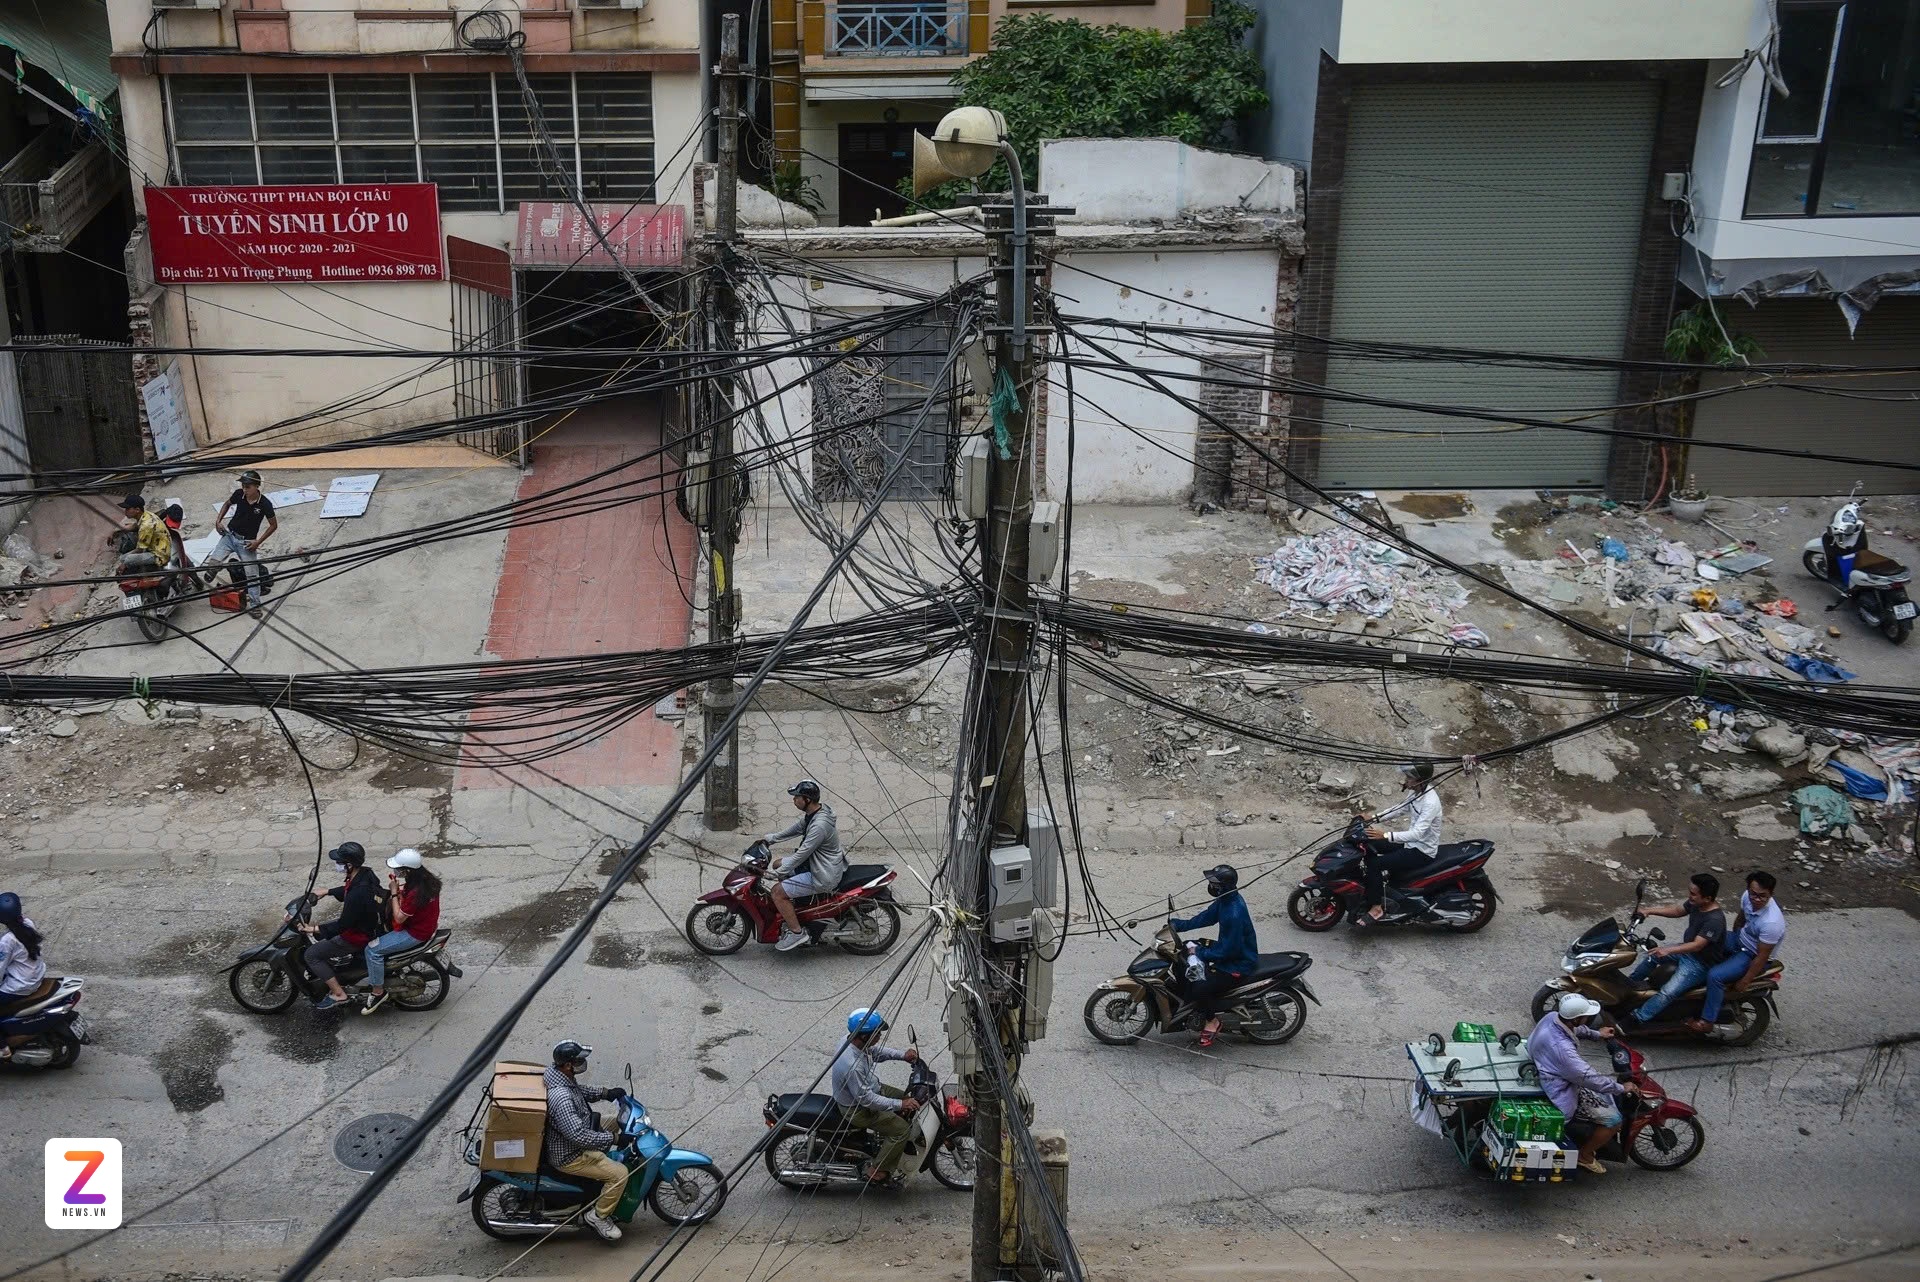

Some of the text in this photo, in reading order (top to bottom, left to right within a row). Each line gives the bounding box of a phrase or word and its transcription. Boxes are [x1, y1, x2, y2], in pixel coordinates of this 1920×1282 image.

[189, 188, 392, 204] TRƯỜNG THPT PHAN BỘI CHÂU
[268, 213, 327, 234] SINH
[331, 207, 380, 233] LỚP
[386, 212, 409, 232] 10
[238, 243, 266, 254] NĂM
[269, 244, 296, 255] HỌC
[299, 244, 323, 253] 2020
[332, 244, 356, 253] 2021
[161, 267, 180, 280] Địa
[206, 267, 219, 277] 21
[222, 266, 238, 277] Vũ
[240, 266, 275, 280] Trọng
[277, 266, 313, 280] Phụng
[321, 265, 365, 276] Hotline:
[367, 265, 394, 276] 0936
[396, 264, 415, 276] 898
[417, 264, 437, 275] 703
